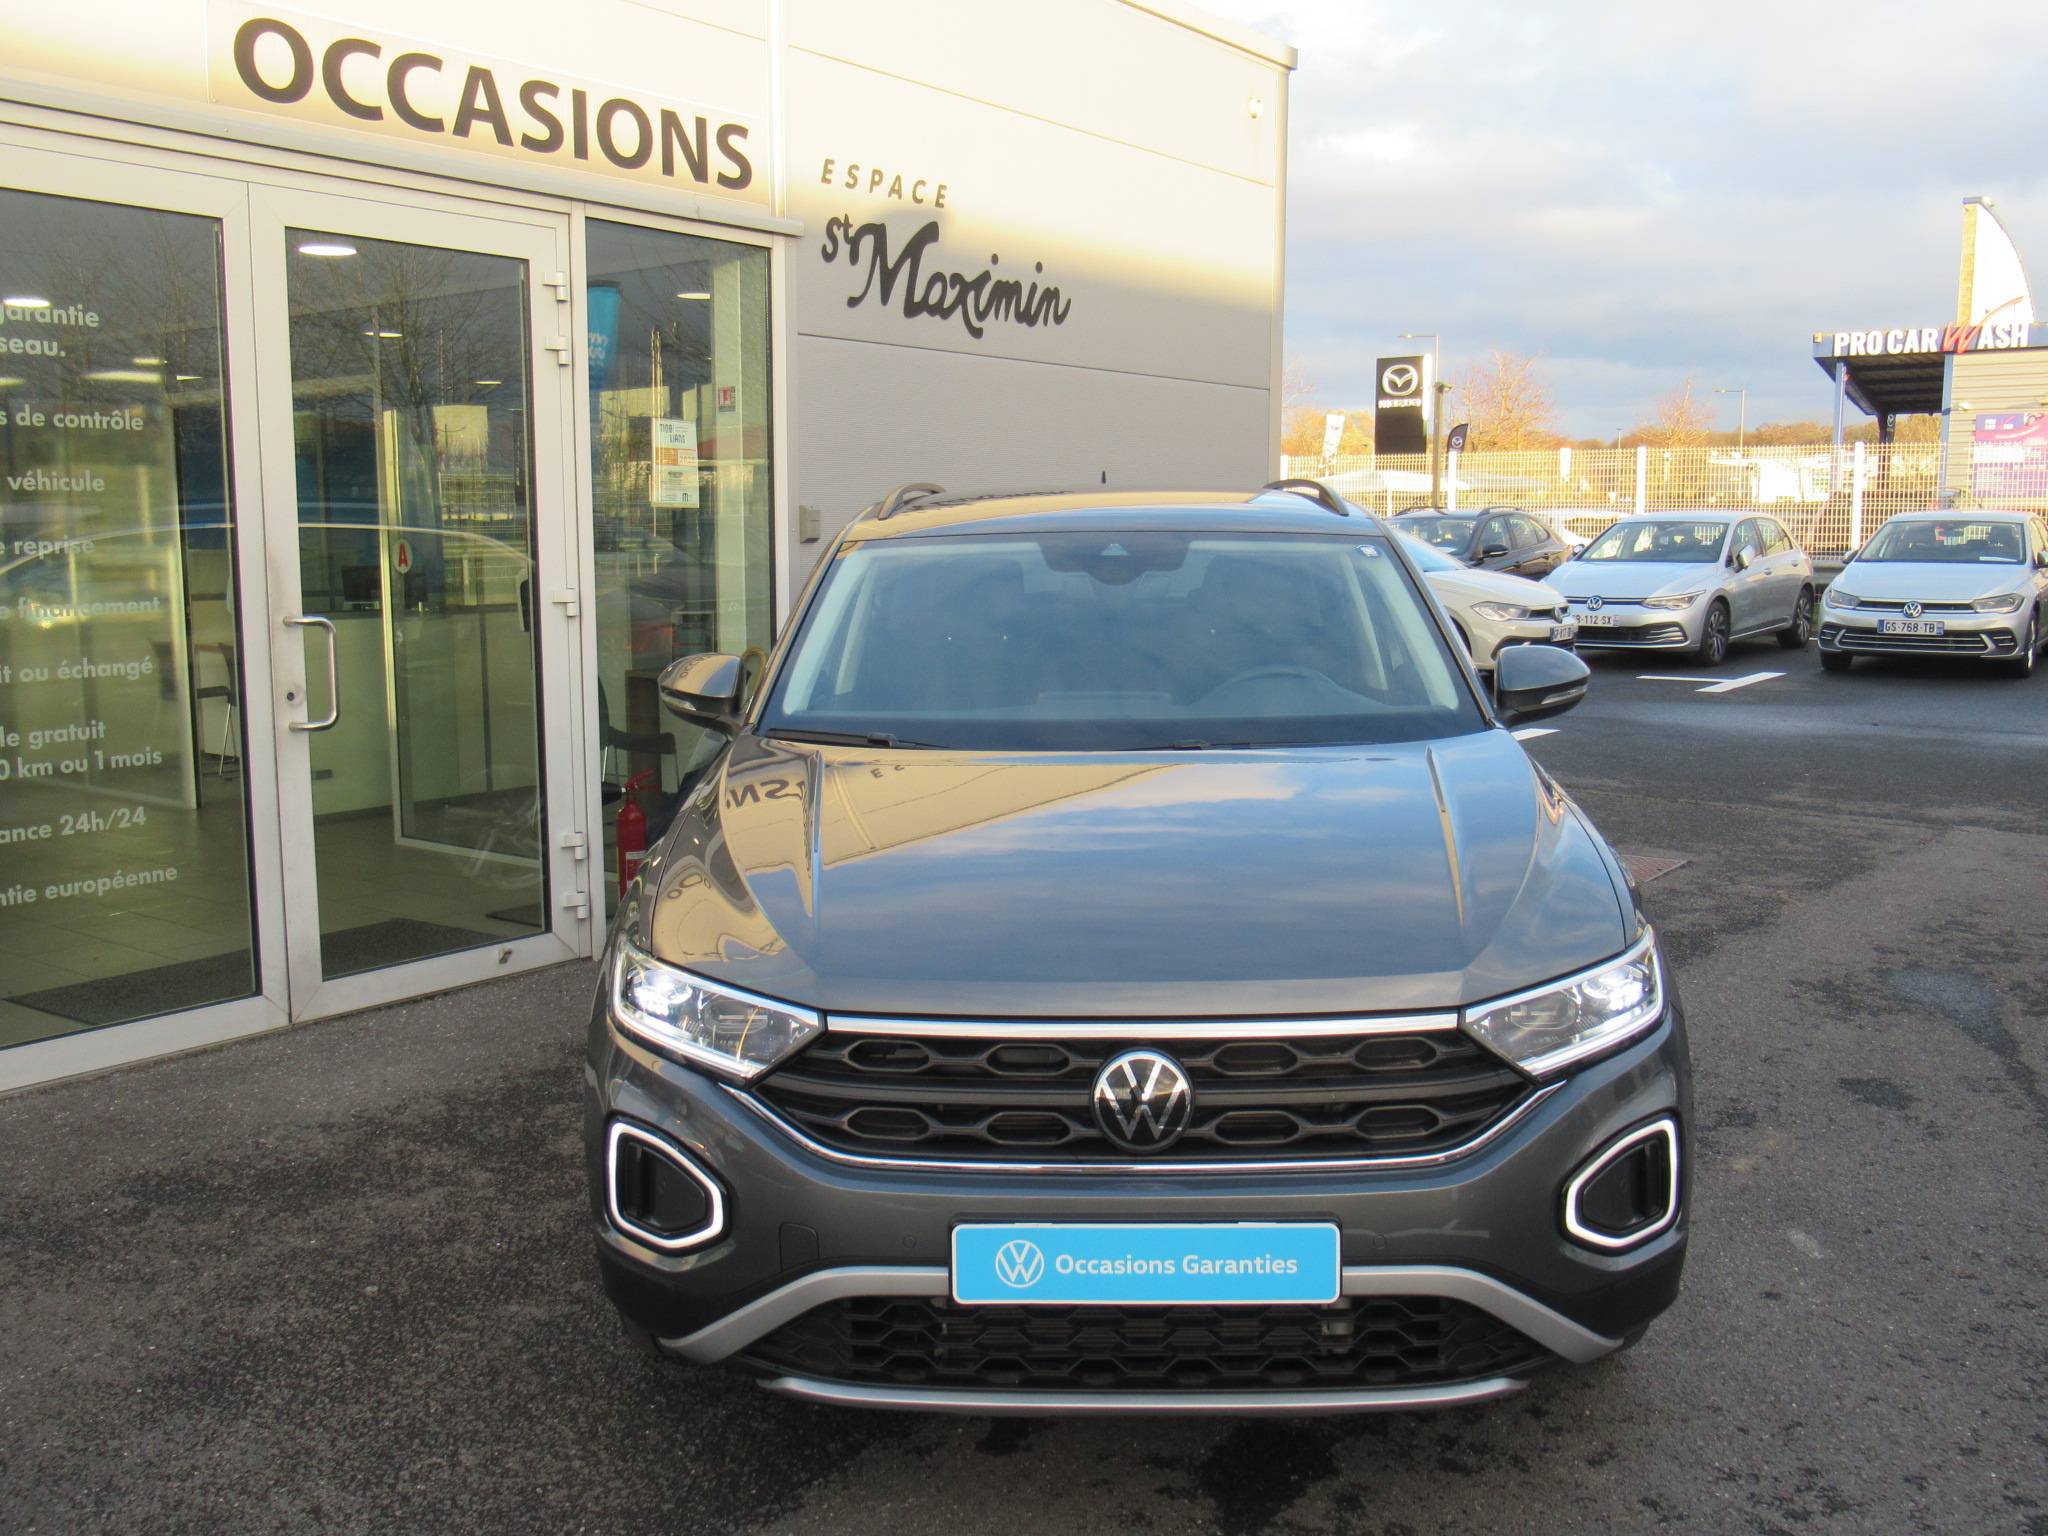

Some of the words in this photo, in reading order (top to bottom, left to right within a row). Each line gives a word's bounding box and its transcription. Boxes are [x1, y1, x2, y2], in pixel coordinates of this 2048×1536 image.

[233, 17, 753, 190] OCCASIONS
[821, 158, 947, 208] ESPACE
[847, 221, 1072, 339] Maximin
[1833, 330, 1883, 357] PRO
[1887, 328, 1938, 354] CAR
[1940, 319, 2028, 355] WASH
[16, 404, 46, 427] de
[53, 409, 144, 431] contrôle
[8, 469, 105, 492] véhicule
[14, 535, 96, 560] reprise
[398, 543, 409, 568] A
[18, 597, 161, 619] financement
[1884, 621, 1936, 633] GS-768-TB
[19, 667, 49, 683] ou
[57, 656, 153, 680] échangé
[29, 720, 106, 750] gratuit
[18, 757, 53, 778] km
[60, 758, 88, 774] ou
[94, 750, 104, 770] 1
[110, 746, 162, 768] mois
[59, 806, 147, 836] 24h/24
[45, 867, 178, 899] européenne
[1055, 1253, 1175, 1275] Occasions
[1182, 1253, 1298, 1275] Garanties
